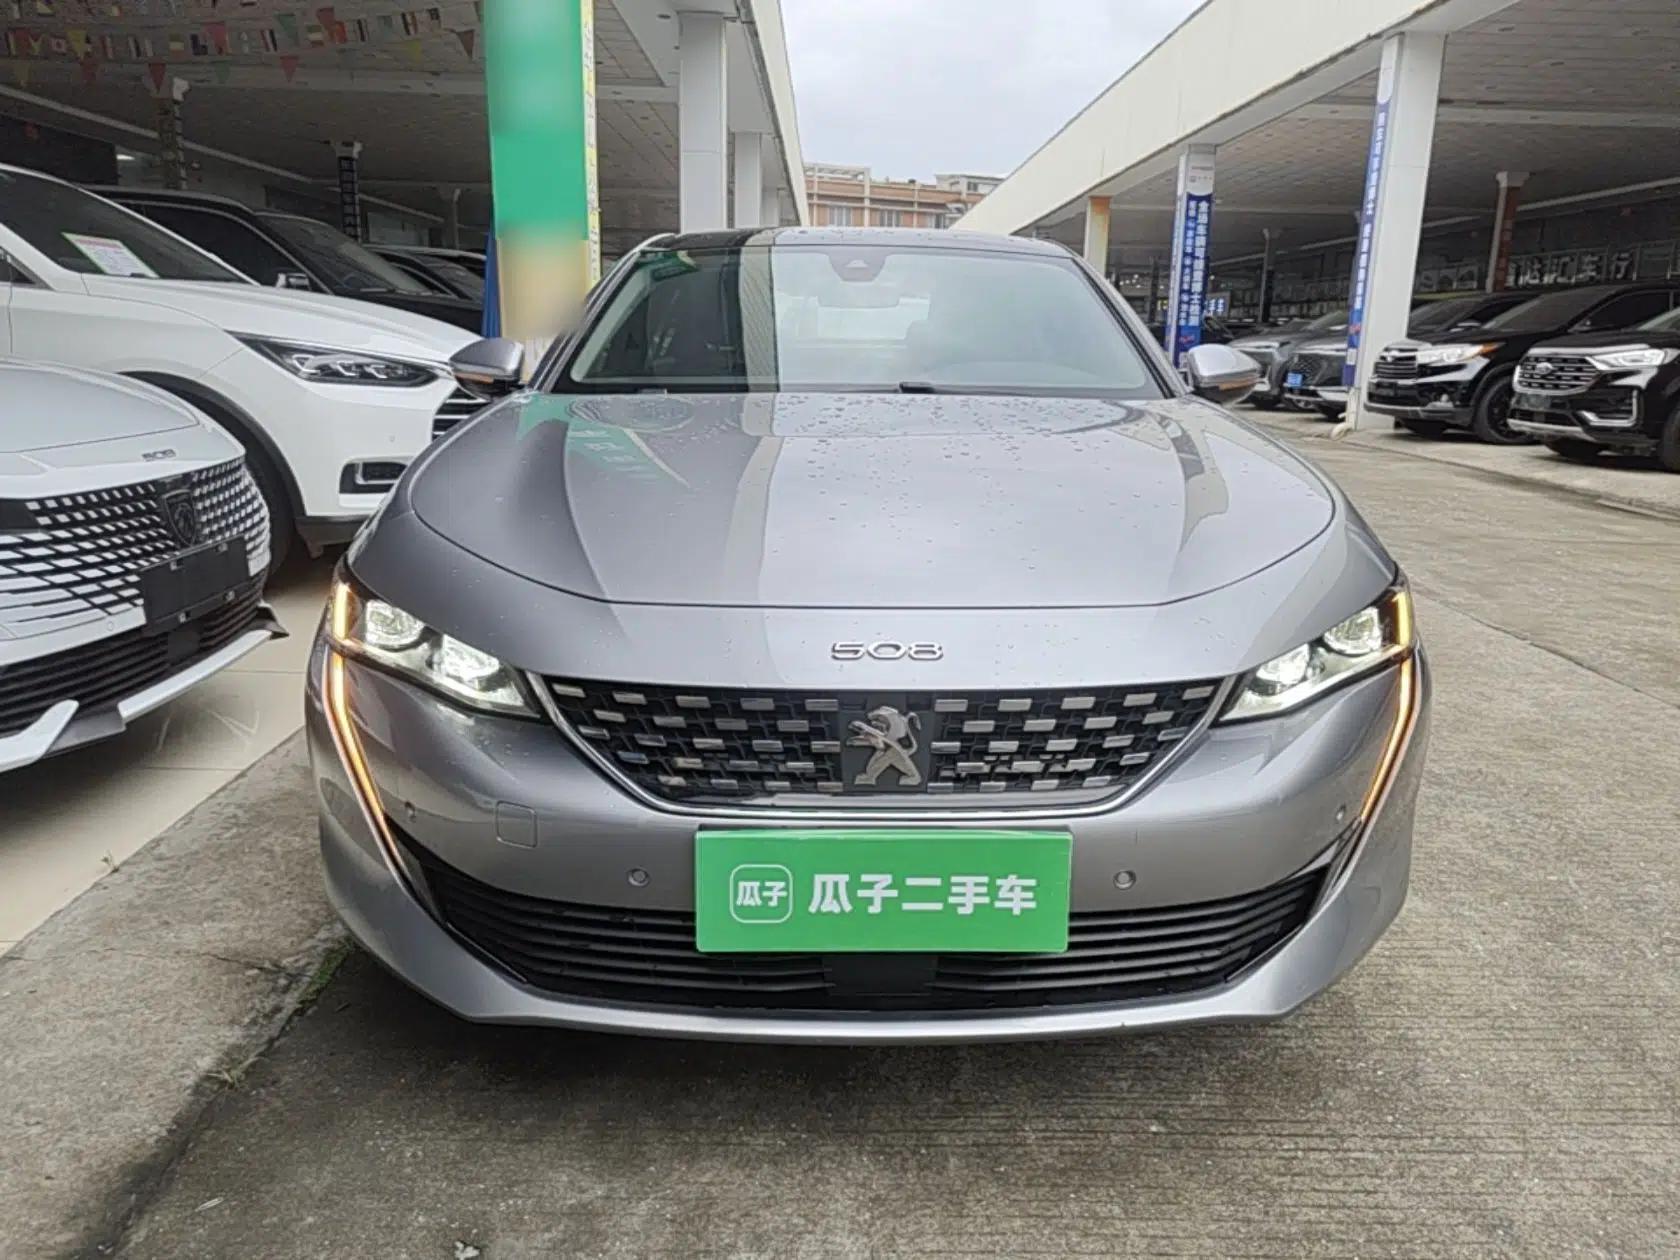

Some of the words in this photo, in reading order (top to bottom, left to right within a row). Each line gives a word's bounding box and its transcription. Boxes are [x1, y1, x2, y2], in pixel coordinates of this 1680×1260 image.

[831, 641, 944, 661] 508
[736, 881, 788, 907] 瓜子
[808, 873, 1038, 916] 瓜子二手车
